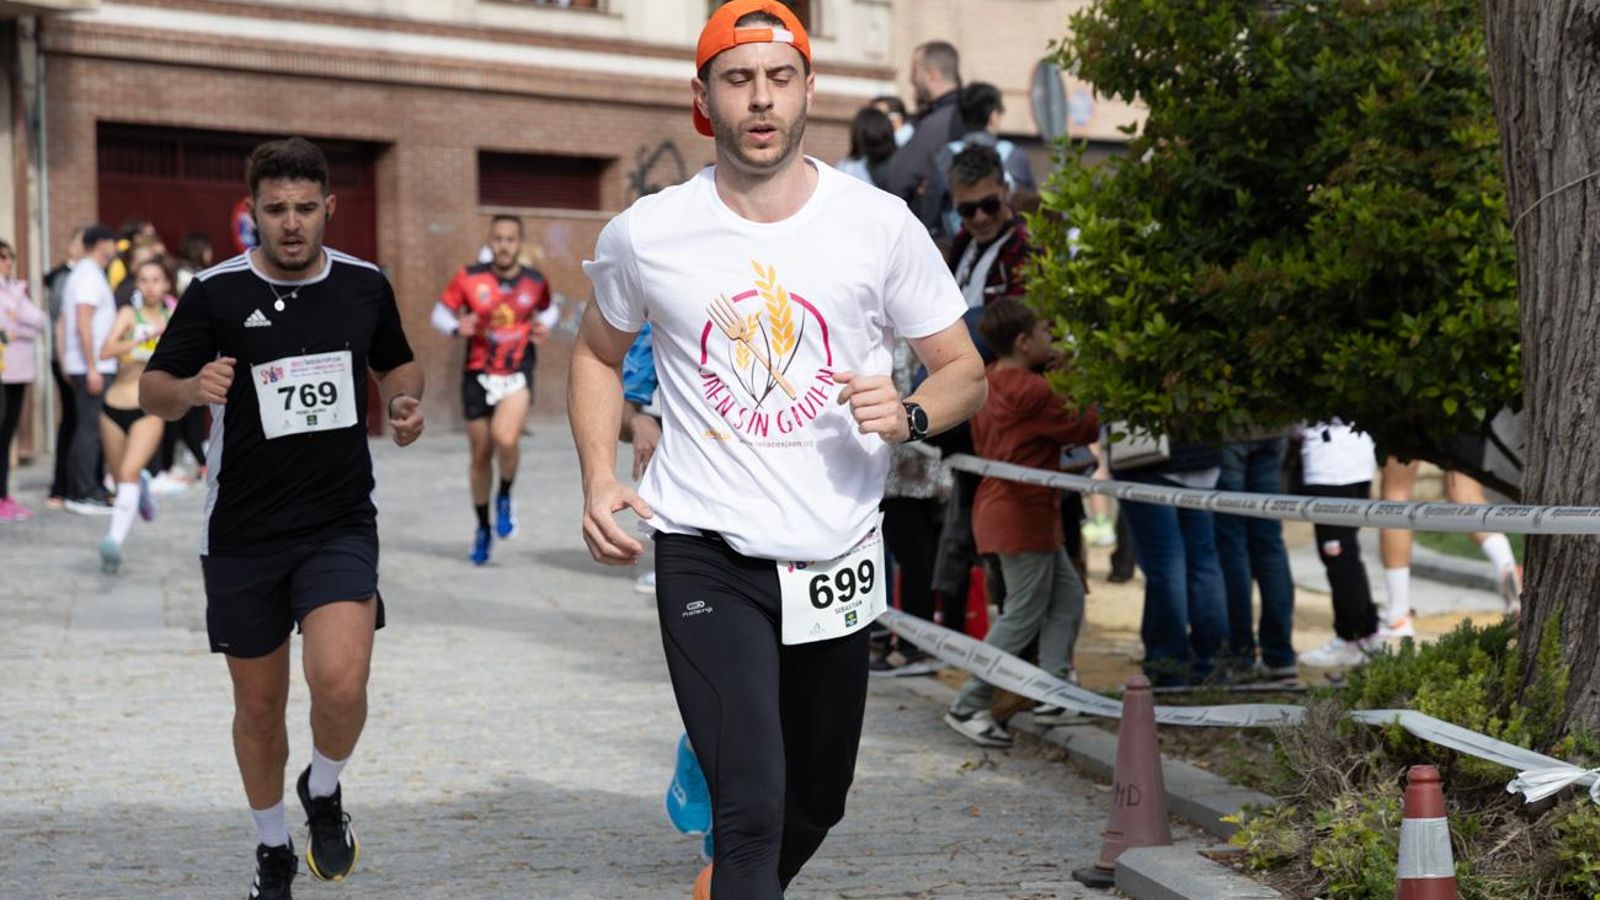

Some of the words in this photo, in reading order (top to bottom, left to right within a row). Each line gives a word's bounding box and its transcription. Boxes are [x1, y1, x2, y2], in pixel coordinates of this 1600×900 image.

[277, 381, 338, 411] 769
[733, 407, 769, 437] SIN
[809, 559, 875, 609] 699
